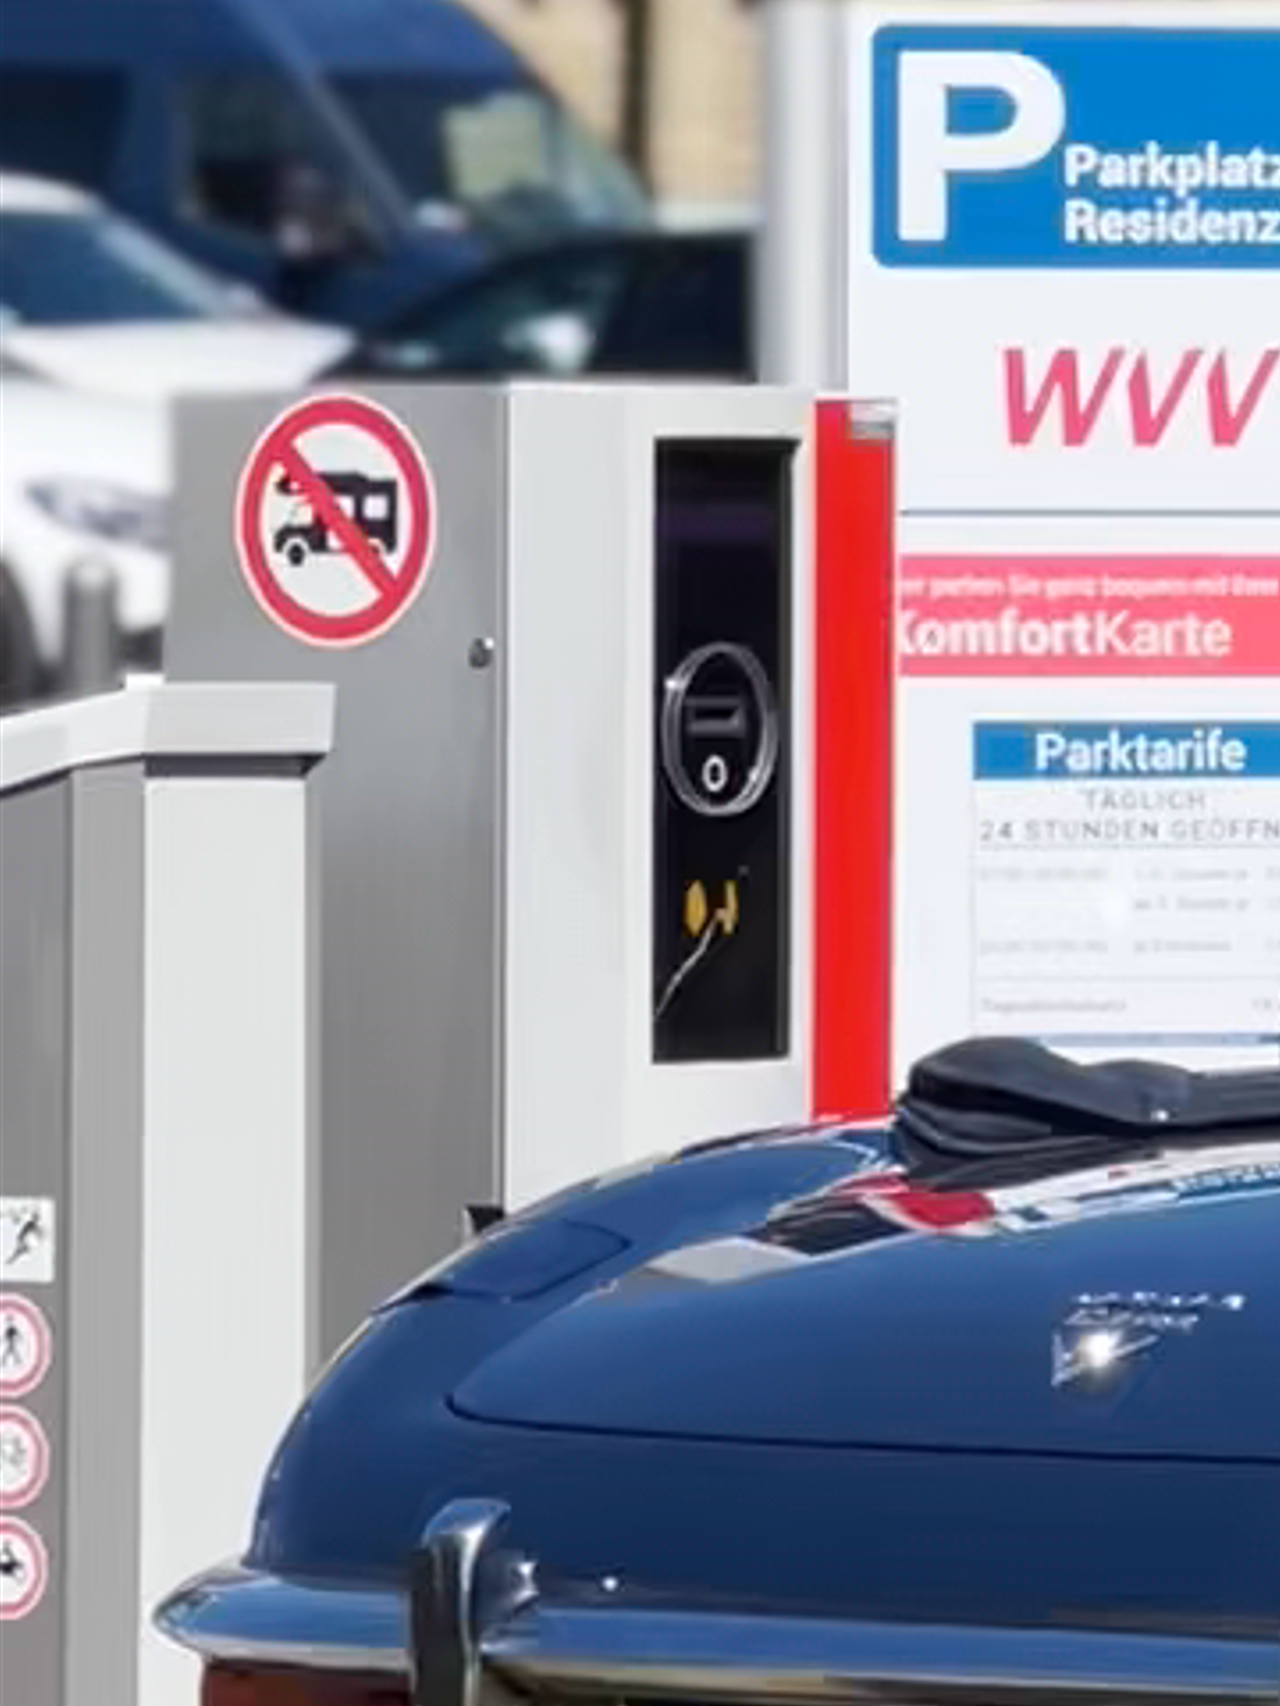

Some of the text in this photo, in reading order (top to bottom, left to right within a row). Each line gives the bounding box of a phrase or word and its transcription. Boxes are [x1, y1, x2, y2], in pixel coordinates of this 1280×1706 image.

[898, 49, 1066, 242] P
[1034, 727, 1248, 772] Parktarife
[979, 819, 1014, 841] 24
[1024, 819, 1160, 841] STUNDEN
